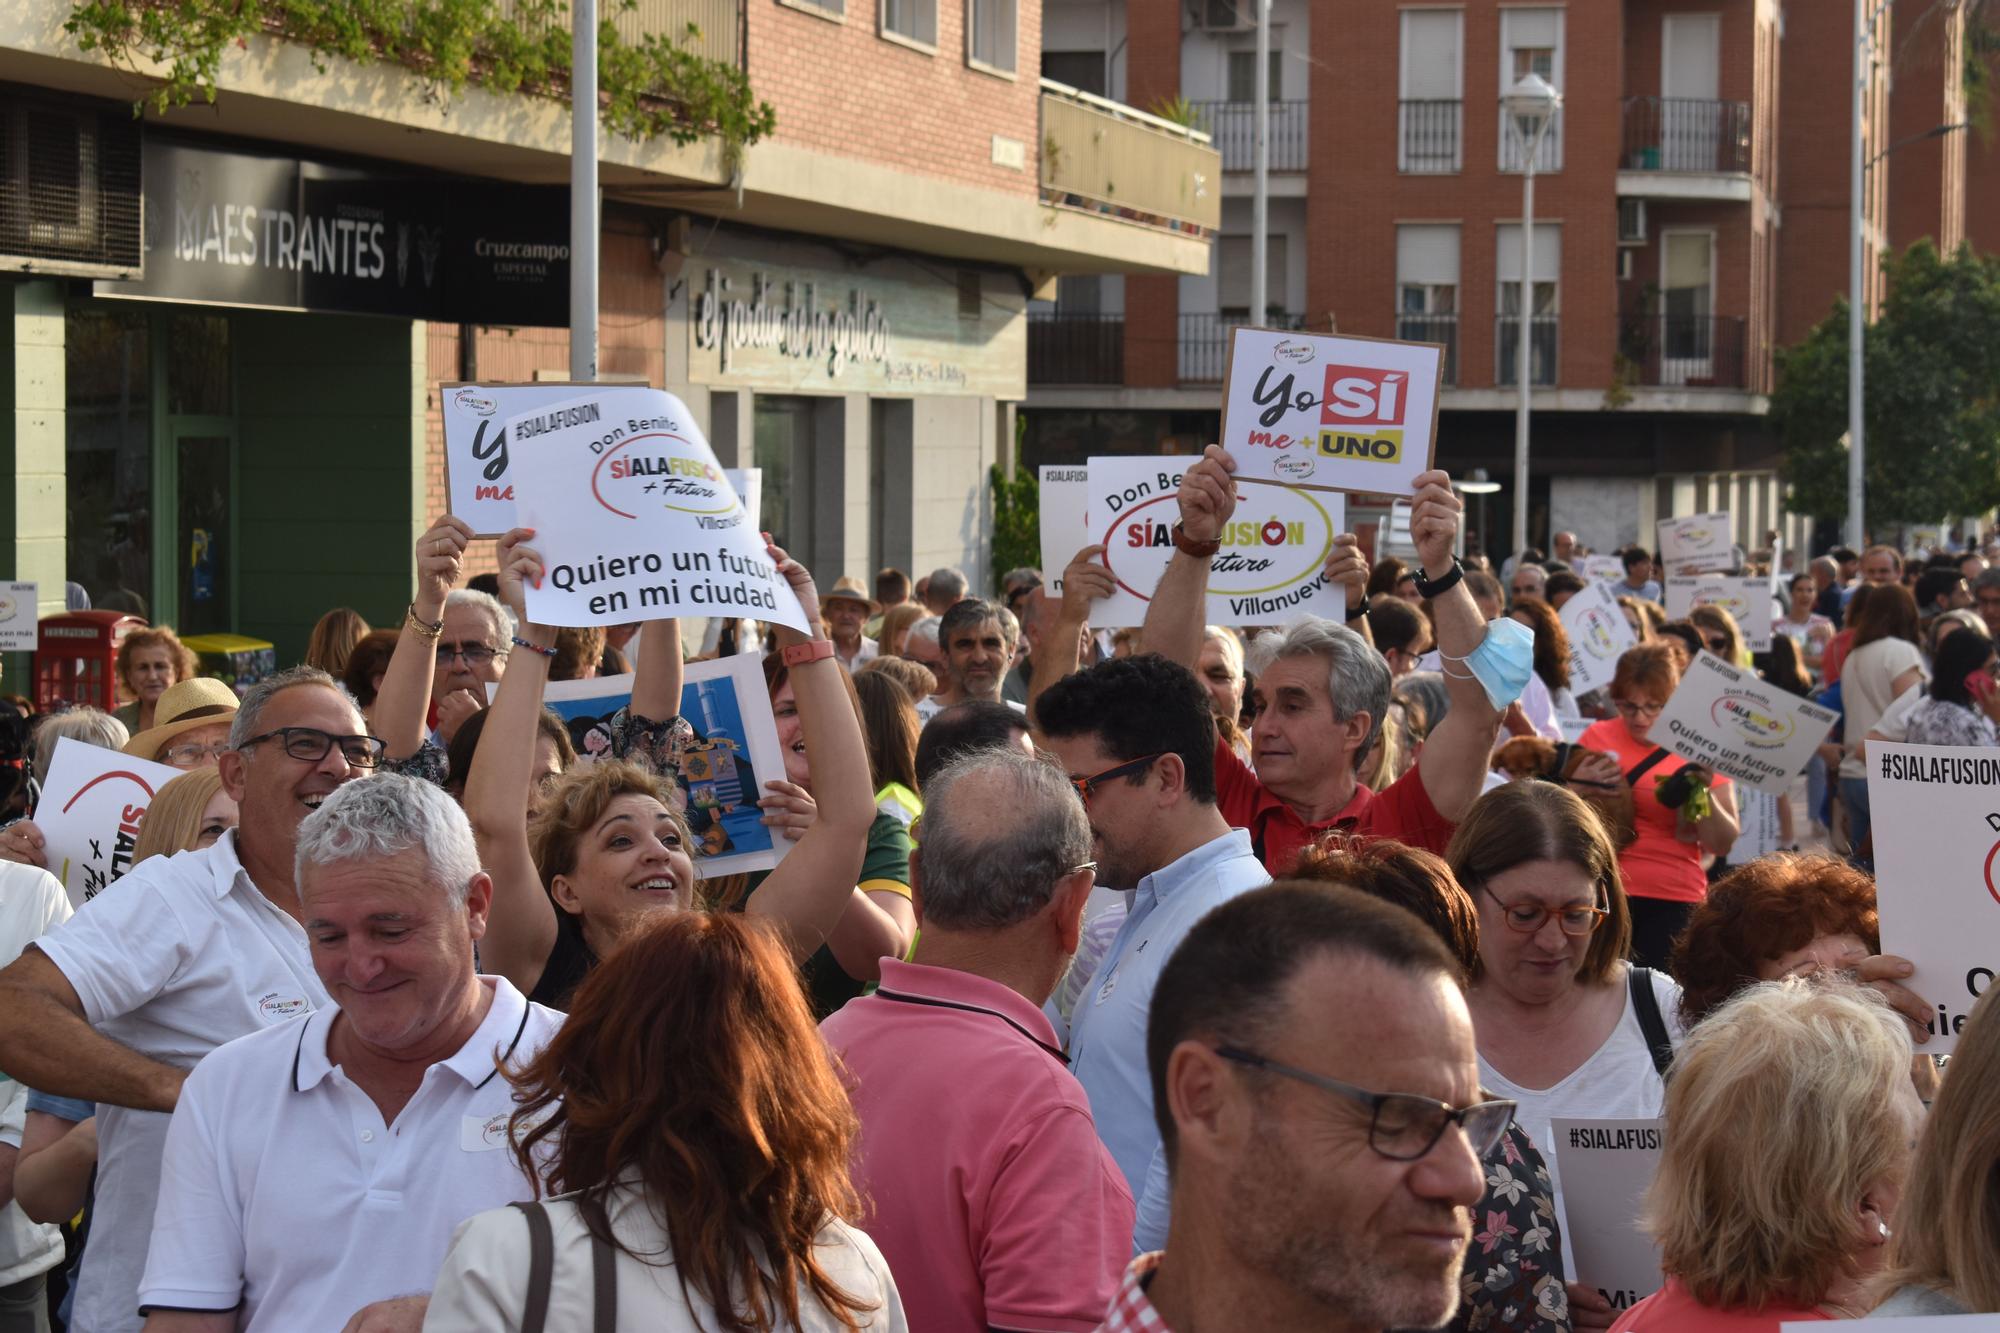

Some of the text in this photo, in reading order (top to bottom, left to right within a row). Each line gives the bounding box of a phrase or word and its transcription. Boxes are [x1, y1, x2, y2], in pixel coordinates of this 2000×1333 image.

[175, 203, 385, 279] MAESTRANTES
[475, 238, 569, 262] Cruzcampo
[494, 262, 548, 275] ESPECIAL
[1253, 366, 1407, 427] Yo SÍ
[516, 402, 600, 441] #SIALAFUSION
[590, 416, 680, 455] Don Benito
[1248, 430, 1295, 449] me
[1322, 435, 1396, 459] UNO
[663, 478, 717, 498] Futuro
[1105, 482, 1151, 513] Don
[551, 553, 662, 593] Quiero
[673, 551, 711, 572] un
[589, 578, 778, 615] en mi ciudad
[1669, 719, 1786, 778] Quiero un futuro
[1675, 739, 1765, 785] en mi ciudad
[1569, 1128, 1663, 1150] #SIALAFUSI
